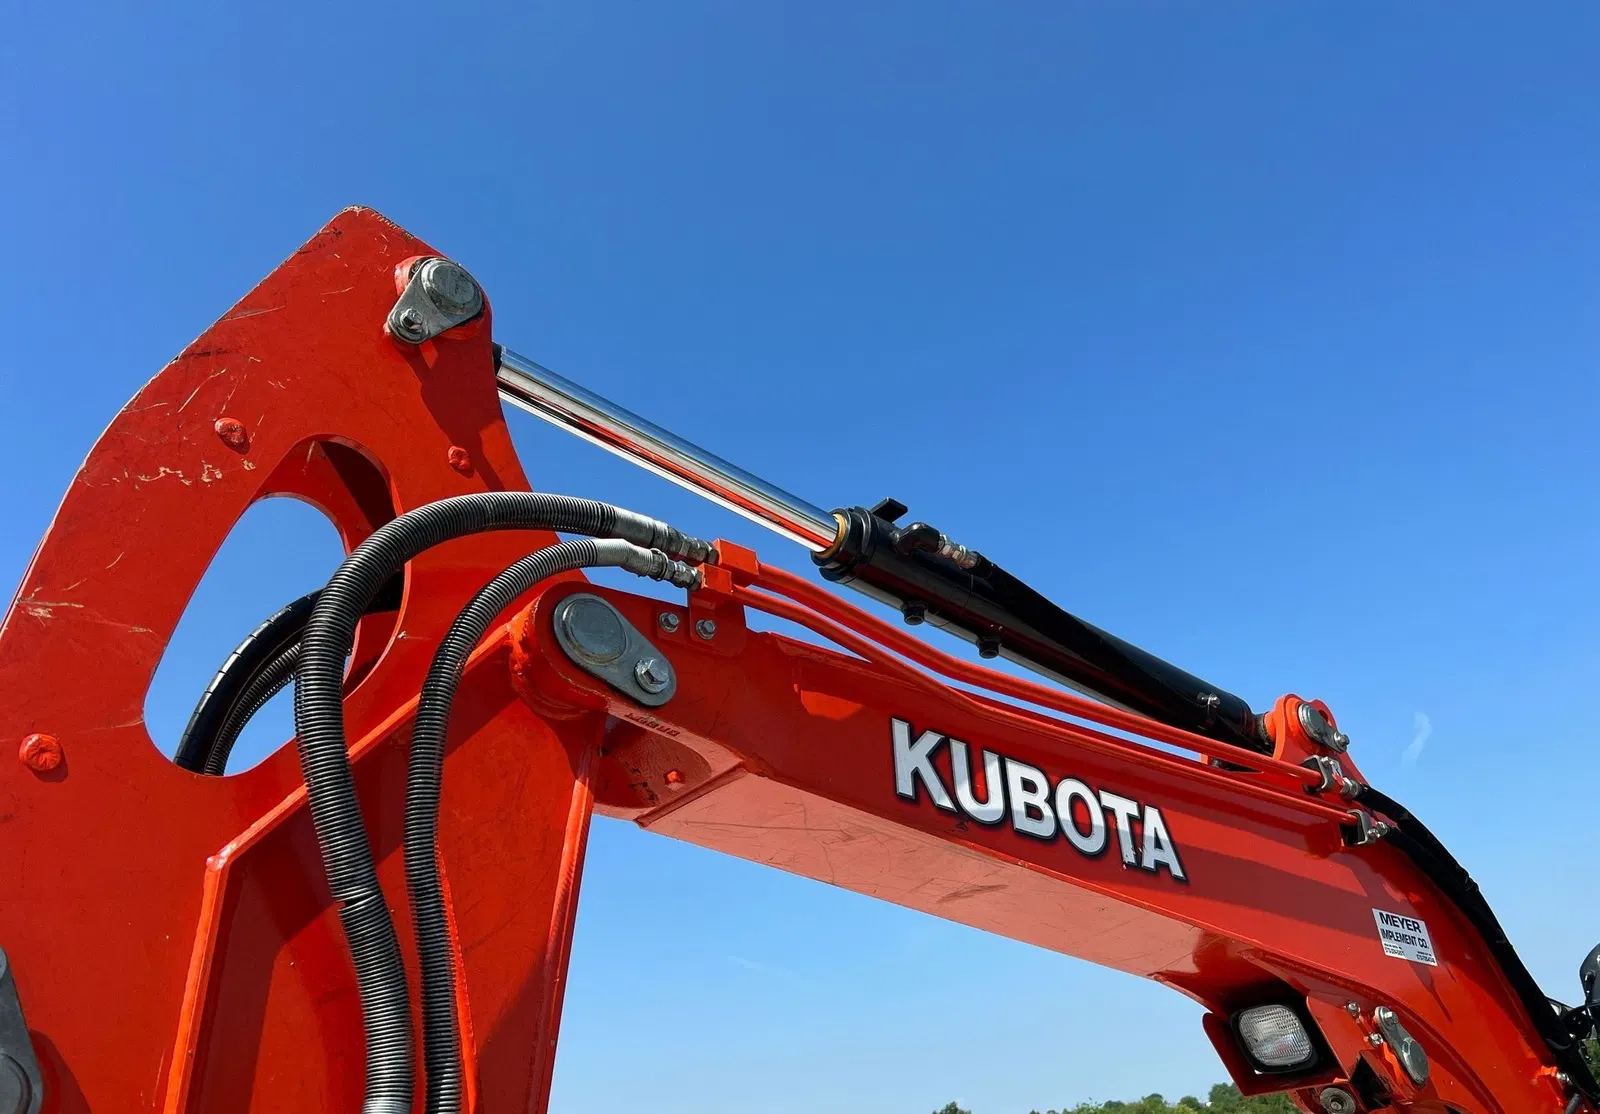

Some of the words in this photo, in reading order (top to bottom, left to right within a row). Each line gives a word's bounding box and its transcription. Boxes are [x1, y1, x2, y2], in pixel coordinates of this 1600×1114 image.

[892, 718, 1186, 880] KUBOTA
[1379, 912, 1421, 933] MEYER
[1380, 929, 1417, 946] IMPLEMENT
[1418, 938, 1429, 949] CO.
